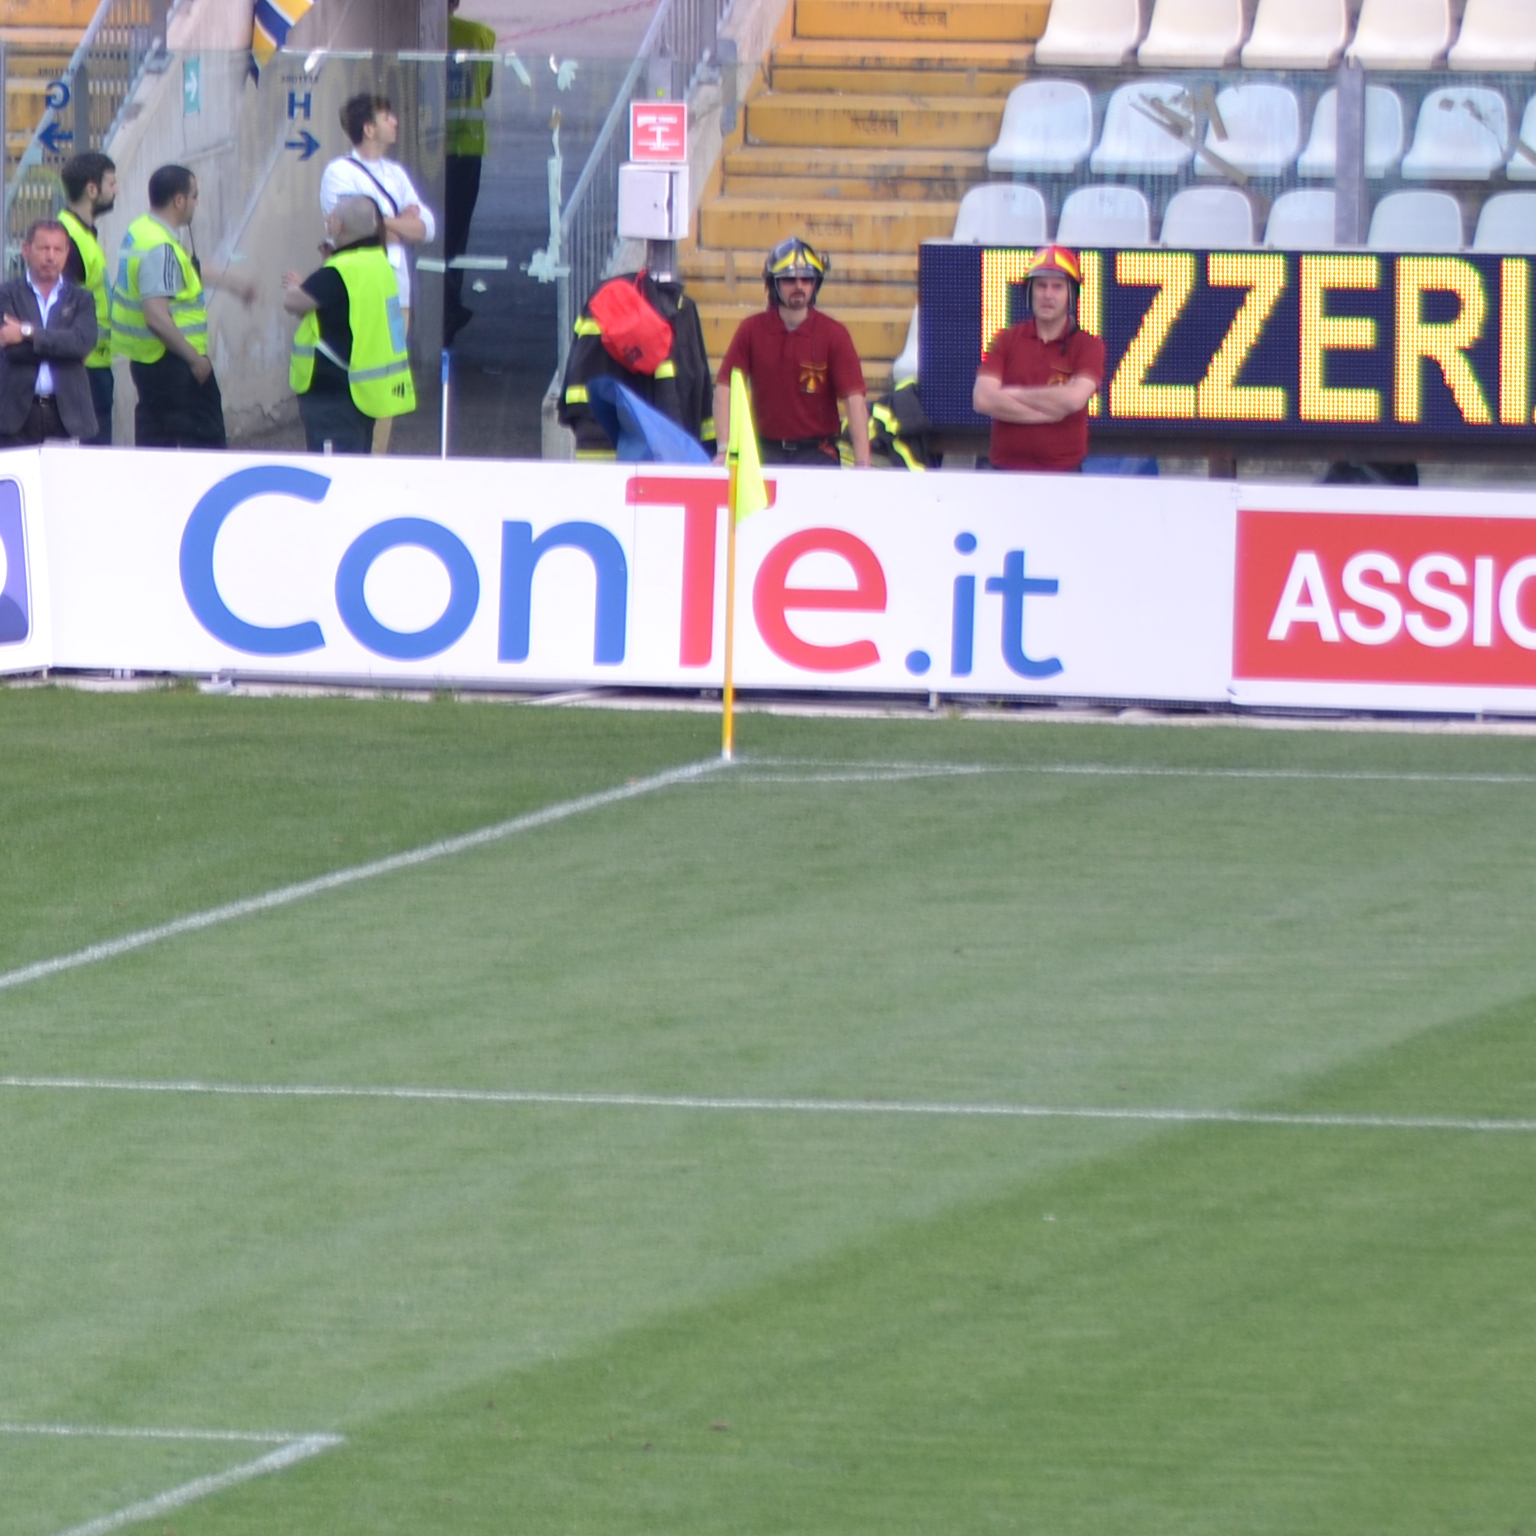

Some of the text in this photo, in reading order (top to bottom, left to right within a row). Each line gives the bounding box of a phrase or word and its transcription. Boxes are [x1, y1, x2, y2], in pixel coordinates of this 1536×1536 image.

[288, 91, 312, 121] H
[981, 248, 1536, 426] IZZERI
[179, 463, 1066, 681] ConTe.it
